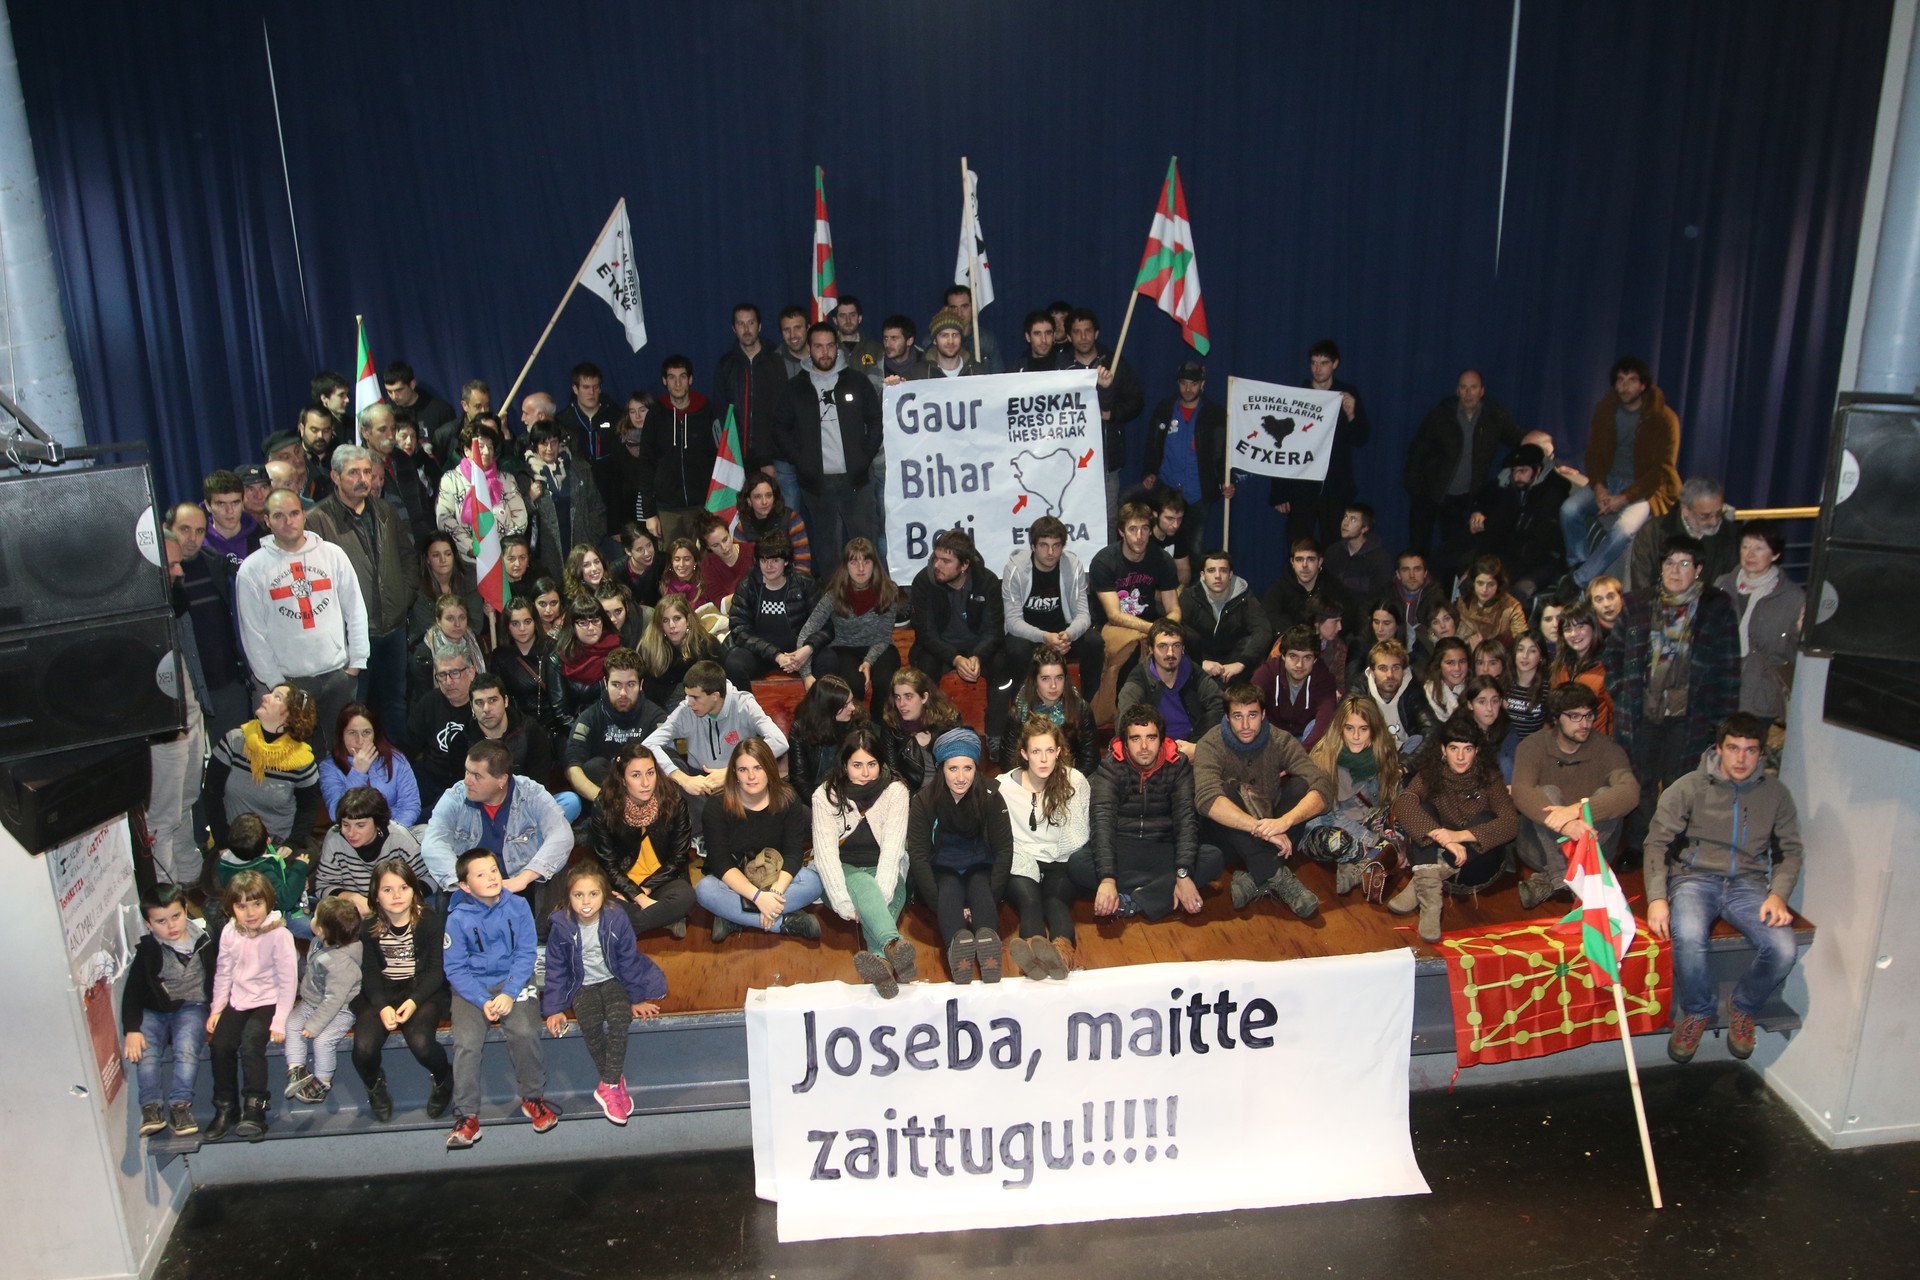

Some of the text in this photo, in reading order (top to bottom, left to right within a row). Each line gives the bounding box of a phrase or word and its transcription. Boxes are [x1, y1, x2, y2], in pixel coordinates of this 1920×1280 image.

[626, 269, 638, 305] PRESO
[896, 392, 982, 434] Gaur
[1007, 392, 1086, 415] EUSKAL
[1243, 403, 1324, 422] ETA IHESLARIAK
[1248, 395, 1322, 413] EUSKAL PRESO
[1008, 411, 1087, 429] PRESO ETA
[1008, 425, 1086, 443] IHESLARIAK
[1235, 439, 1314, 466] ETXERA
[901, 453, 995, 499] Bihar
[1012, 523, 1090, 545] ETRA
[792, 987, 1278, 1094] Joseba, maitte
[807, 1095, 1180, 1189] zaittugu!!!!!
